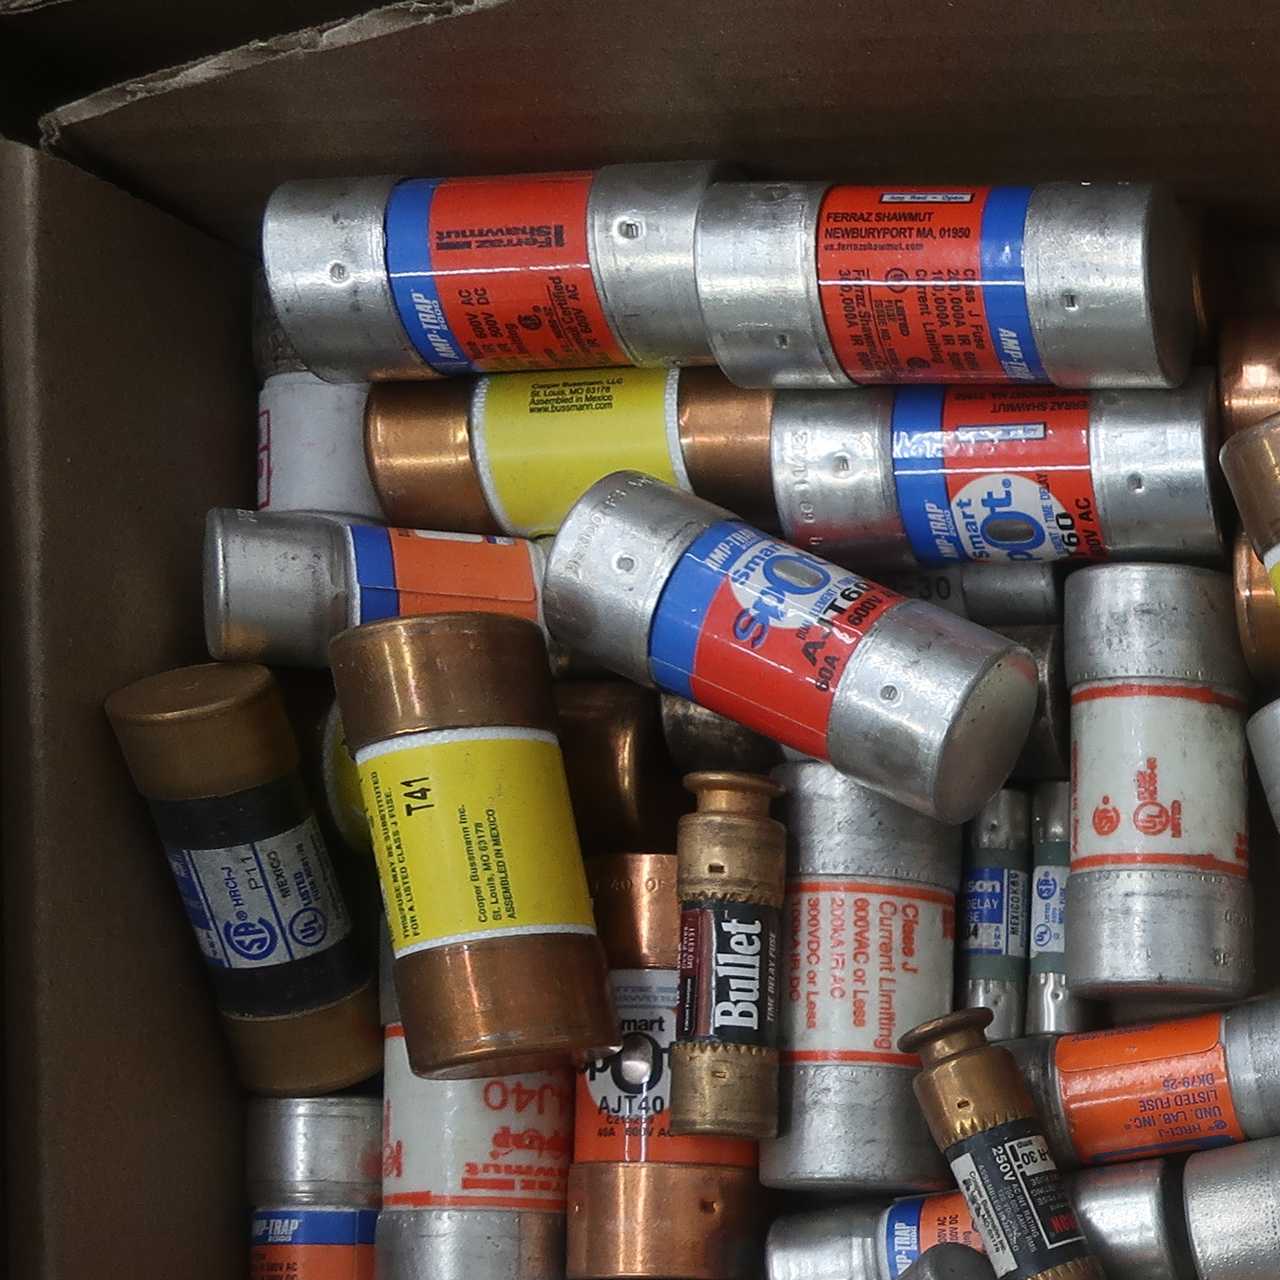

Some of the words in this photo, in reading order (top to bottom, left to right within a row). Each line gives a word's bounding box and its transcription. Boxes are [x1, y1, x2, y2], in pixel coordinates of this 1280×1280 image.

[824, 227, 914, 238] NEWBURYPORT
[916, 227, 937, 239] MA,
[940, 228, 971, 238] 01950
[827, 212, 873, 222] FERRAZ
[874, 212, 934, 222] SHAWMUT
[413, 292, 459, 360] AMP-TRAP
[529, 403, 613, 413] www.bussmann.com
[585, 394, 613, 402] Mexico
[956, 498, 990, 560] Smart
[1075, 498, 1093, 523] AC
[814, 654, 840, 692] 60A
[400, 777, 434, 816] T41
[486, 809, 502, 847] MEXICO
[462, 824, 480, 882] Bussmann
[480, 854, 492, 871] MO
[266, 850, 291, 898] MEXICO
[496, 862, 517, 919] ASSEMBLED
[473, 885, 488, 923] Cooper
[853, 897, 870, 964] 600VAC
[879, 901, 897, 973] Current
[902, 903, 918, 957] Class
[714, 918, 762, 1030] Bullet
[853, 990, 869, 1027] Less
[874, 977, 896, 1049] Limiting
[599, 1095, 664, 1114] AJT40
[1140, 1099, 1171, 1112] FUSE
[1175, 1089, 1218, 1106] LISTED
[1191, 1105, 1222, 1120] UND.
[1162, 1111, 1188, 1124] LAB.
[992, 1146, 1016, 1181] 250V
